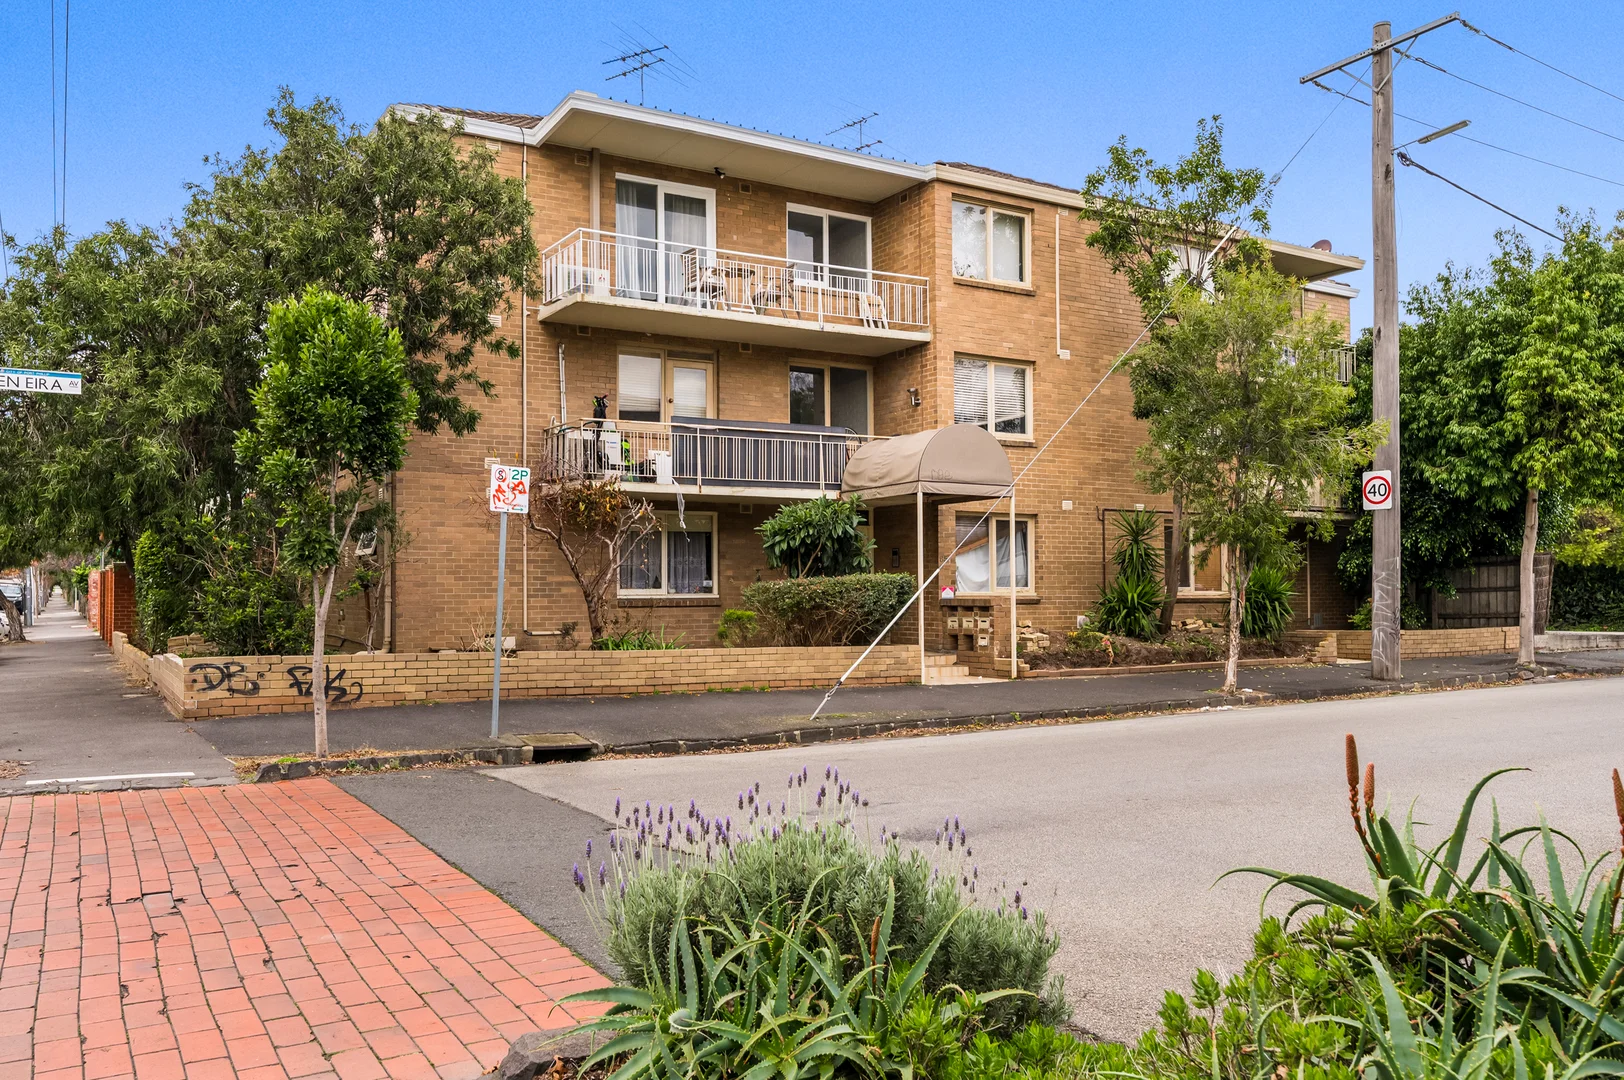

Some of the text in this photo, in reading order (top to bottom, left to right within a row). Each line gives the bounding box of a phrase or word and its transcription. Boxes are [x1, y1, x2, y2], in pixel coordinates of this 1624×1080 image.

[26, 377, 63, 391] EIRA
[511, 469, 529, 480] 2P
[1367, 483, 1387, 497] 40
